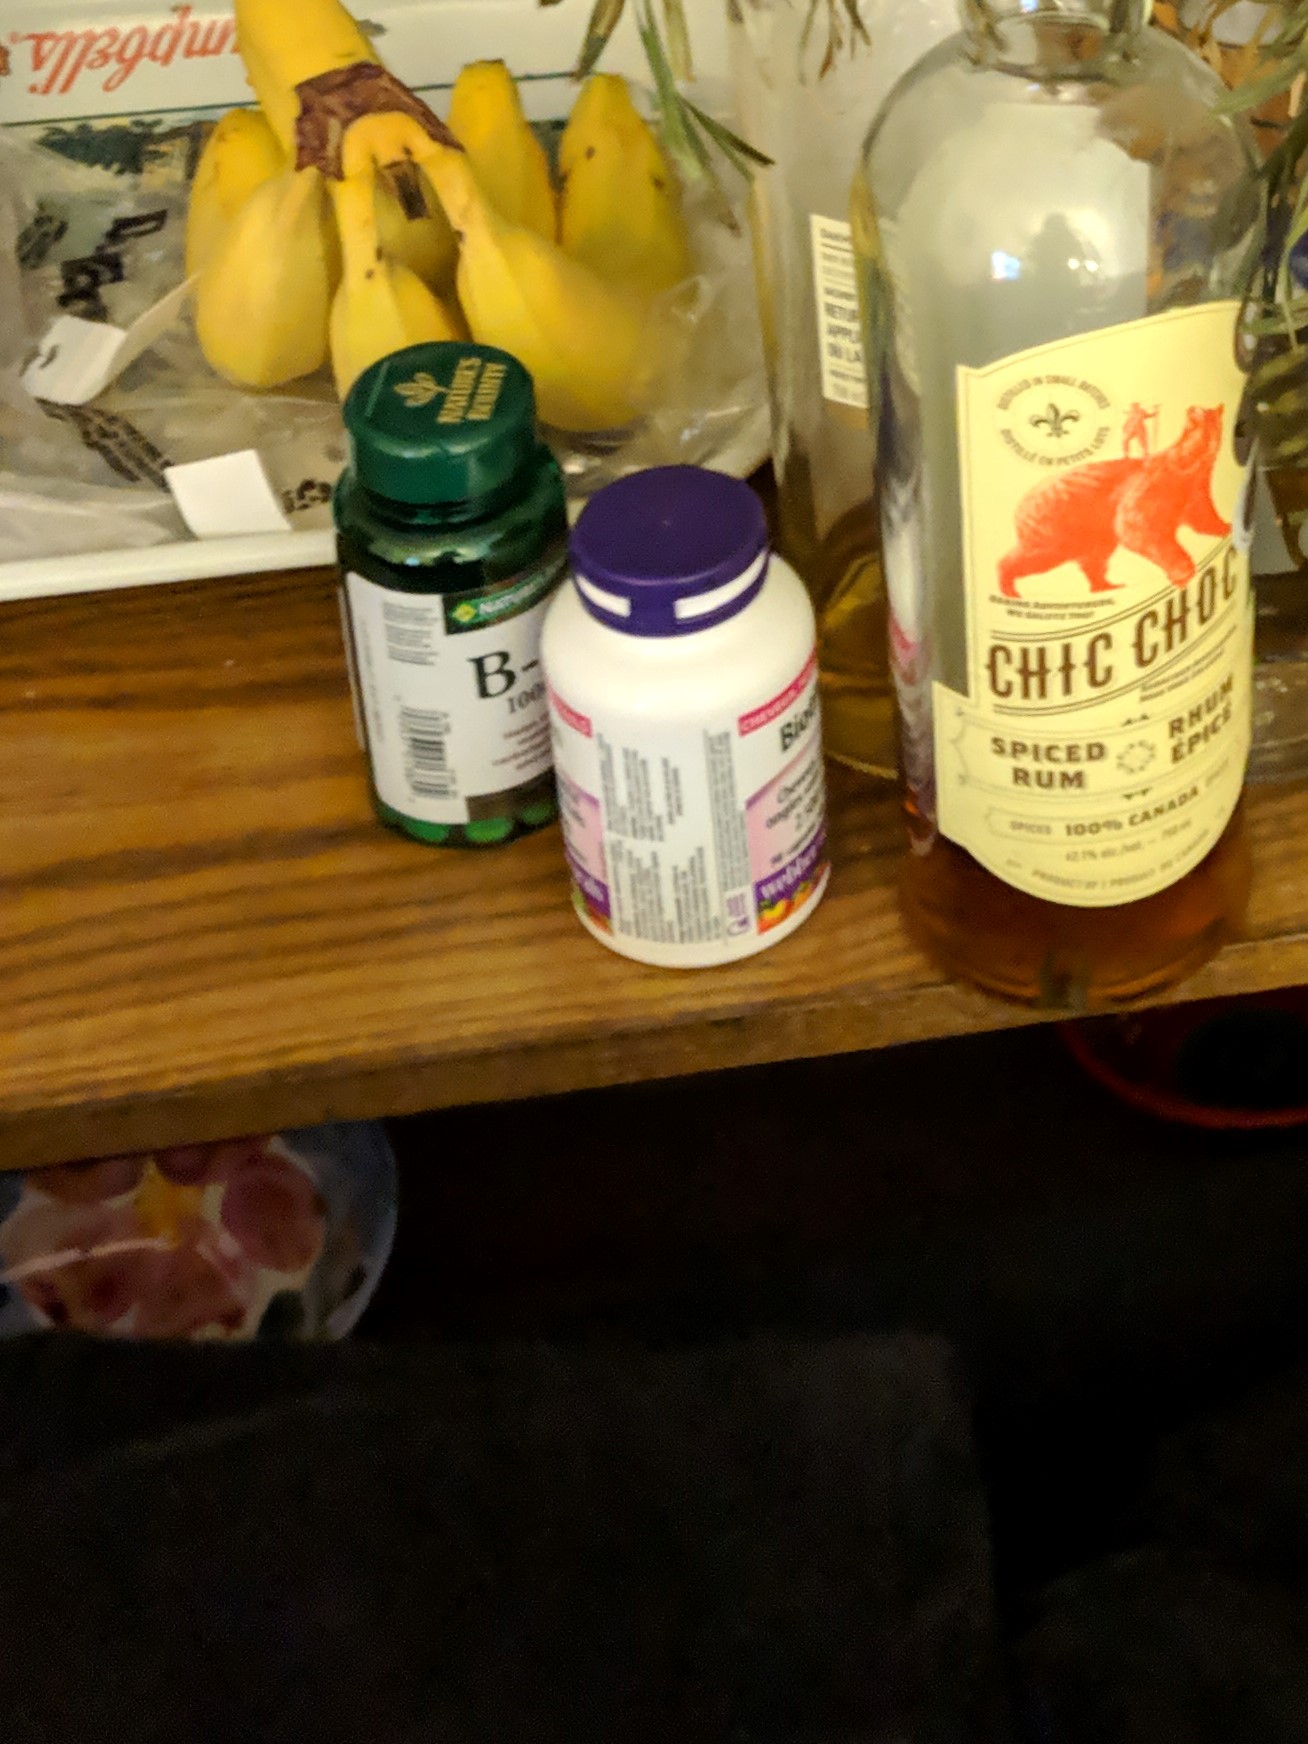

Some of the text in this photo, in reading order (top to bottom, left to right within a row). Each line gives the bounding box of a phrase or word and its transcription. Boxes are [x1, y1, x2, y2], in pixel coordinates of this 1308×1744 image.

[986, 632, 1113, 700] CHIC
[1132, 547, 1238, 669] CHOC
[1169, 673, 1232, 738] RHUM
[991, 737, 1106, 763] SPICED
[1012, 768, 1086, 789] RUM
[1065, 822, 1123, 837] 100%
[1128, 787, 1199, 827] CANADA
